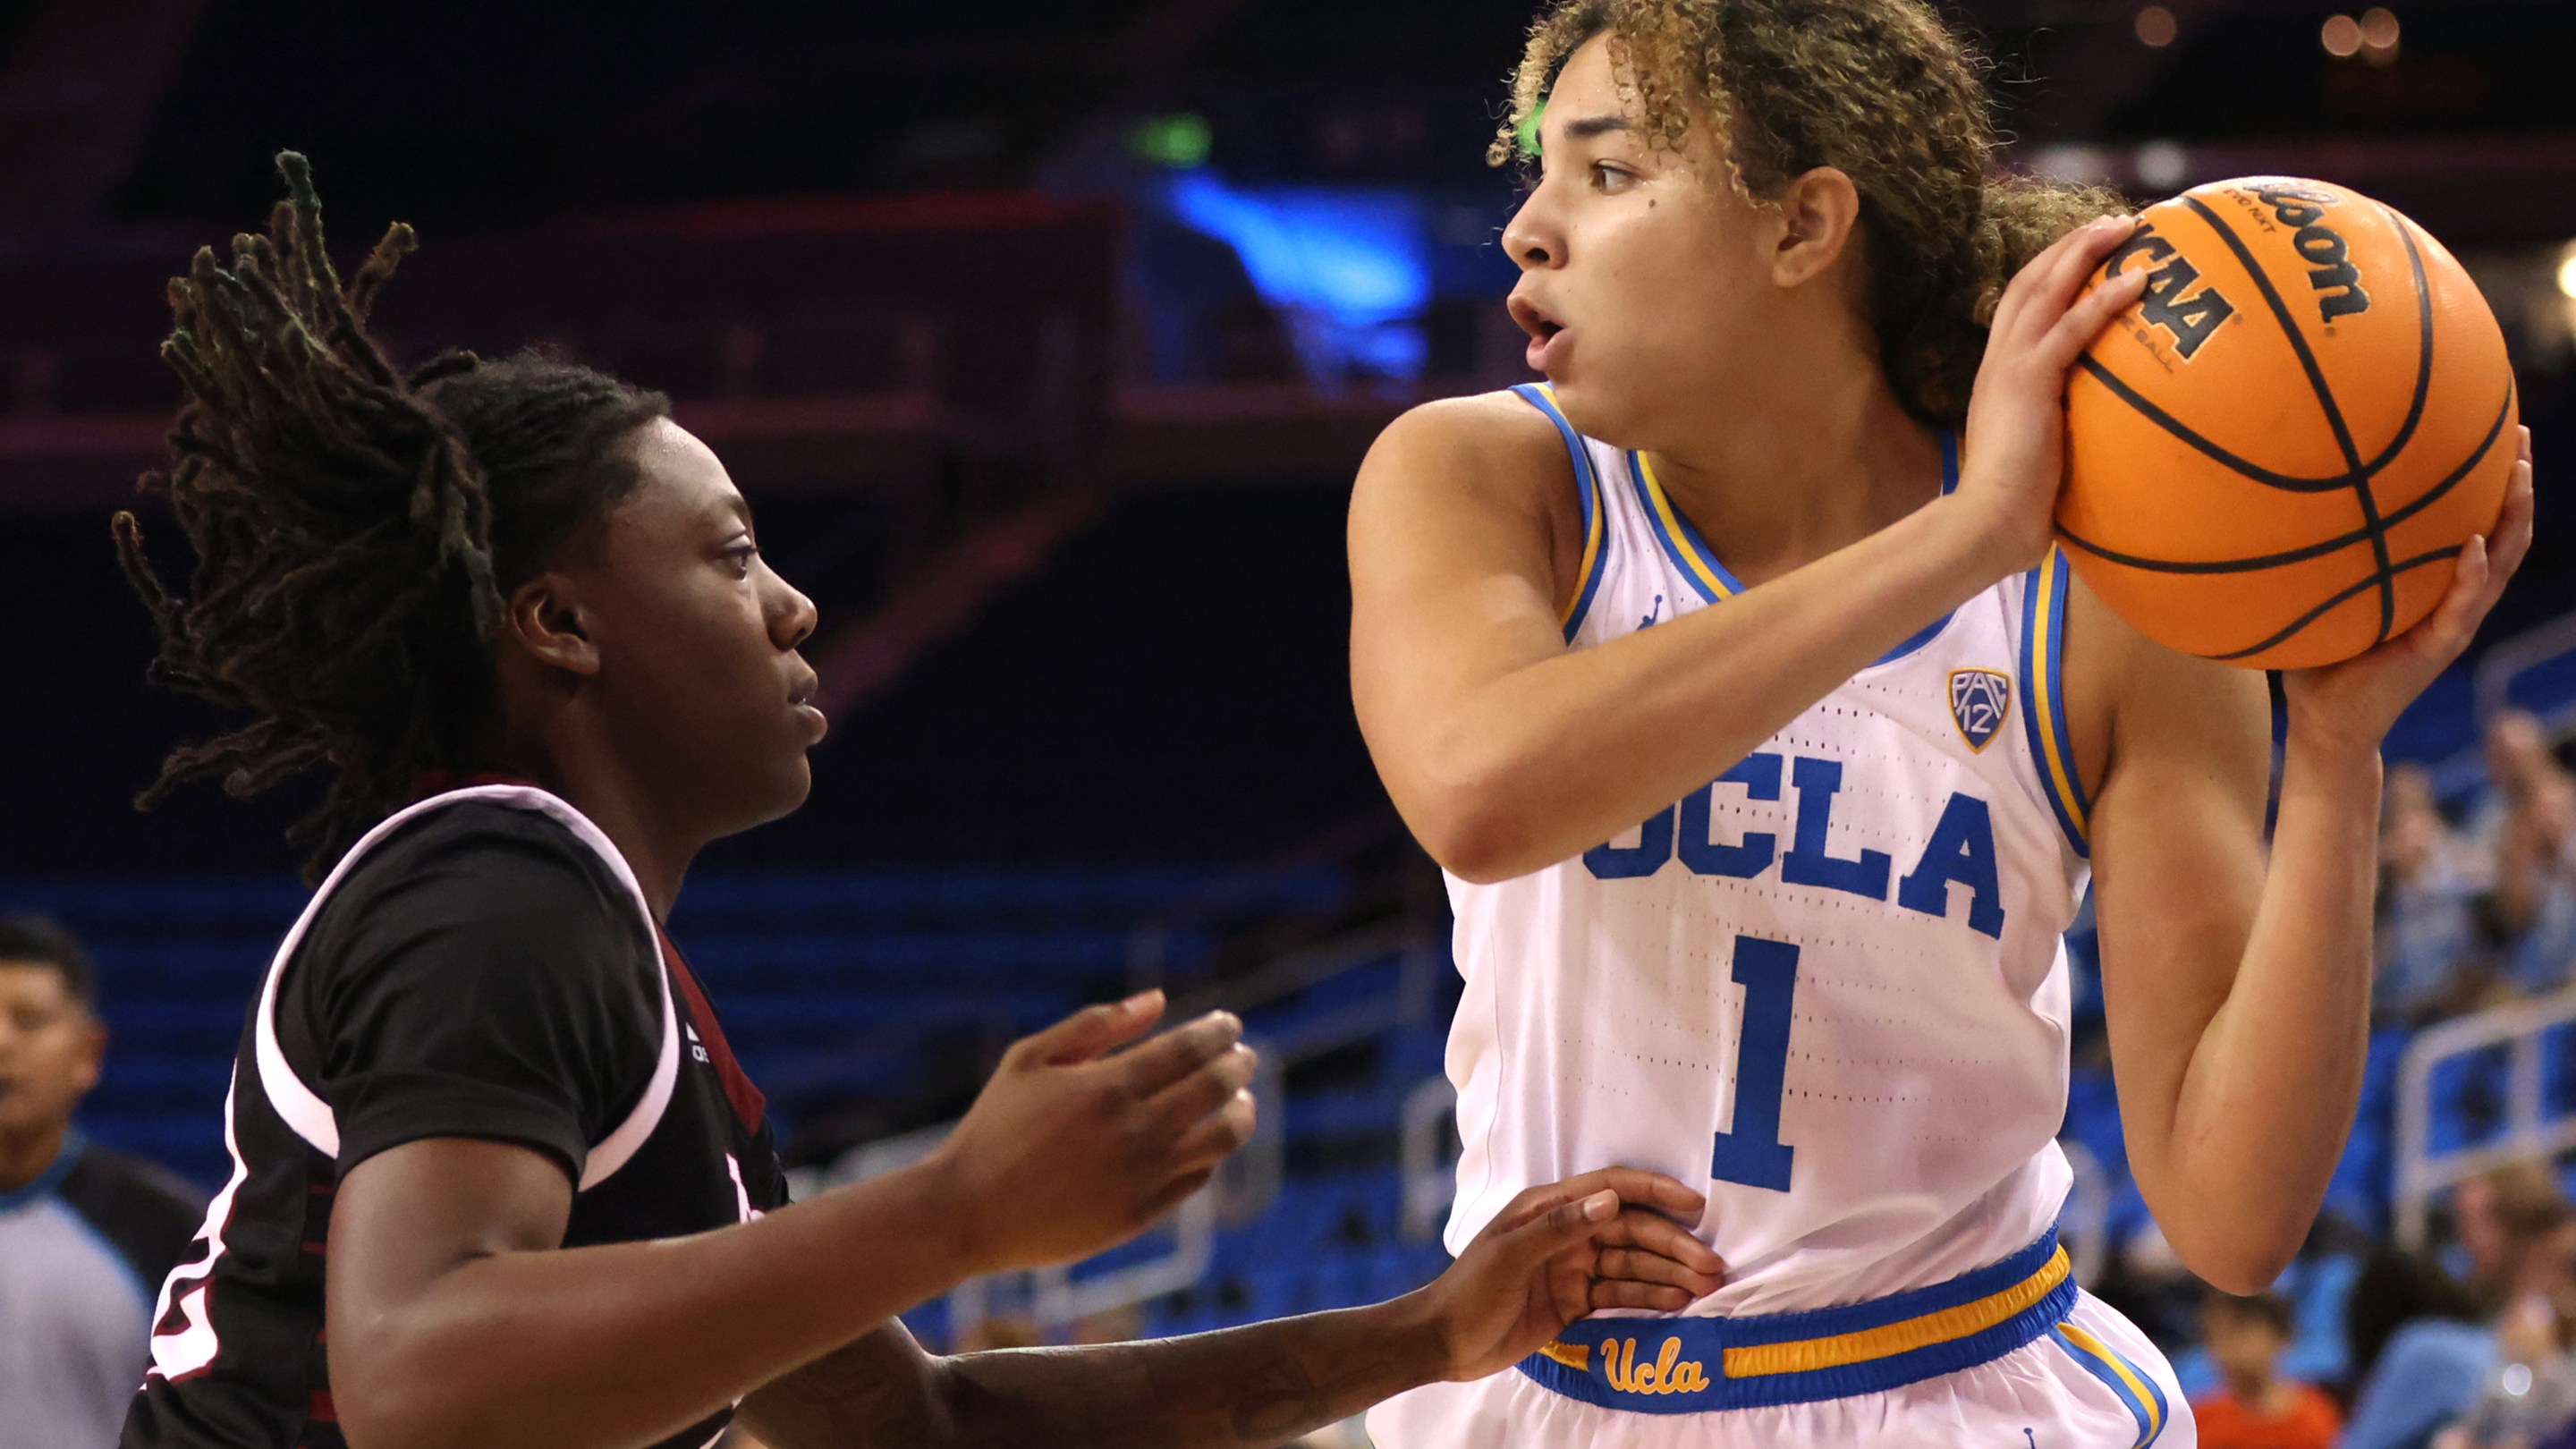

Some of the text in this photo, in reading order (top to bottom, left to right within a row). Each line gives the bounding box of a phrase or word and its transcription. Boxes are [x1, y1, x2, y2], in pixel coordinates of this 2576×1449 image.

[2249, 207, 2276, 233] NXT
[1951, 672, 2008, 719] PAC
[1963, 703, 1994, 733] 12
[1710, 934, 1801, 1193] 1
[1600, 1335, 1710, 1394] Ucla
